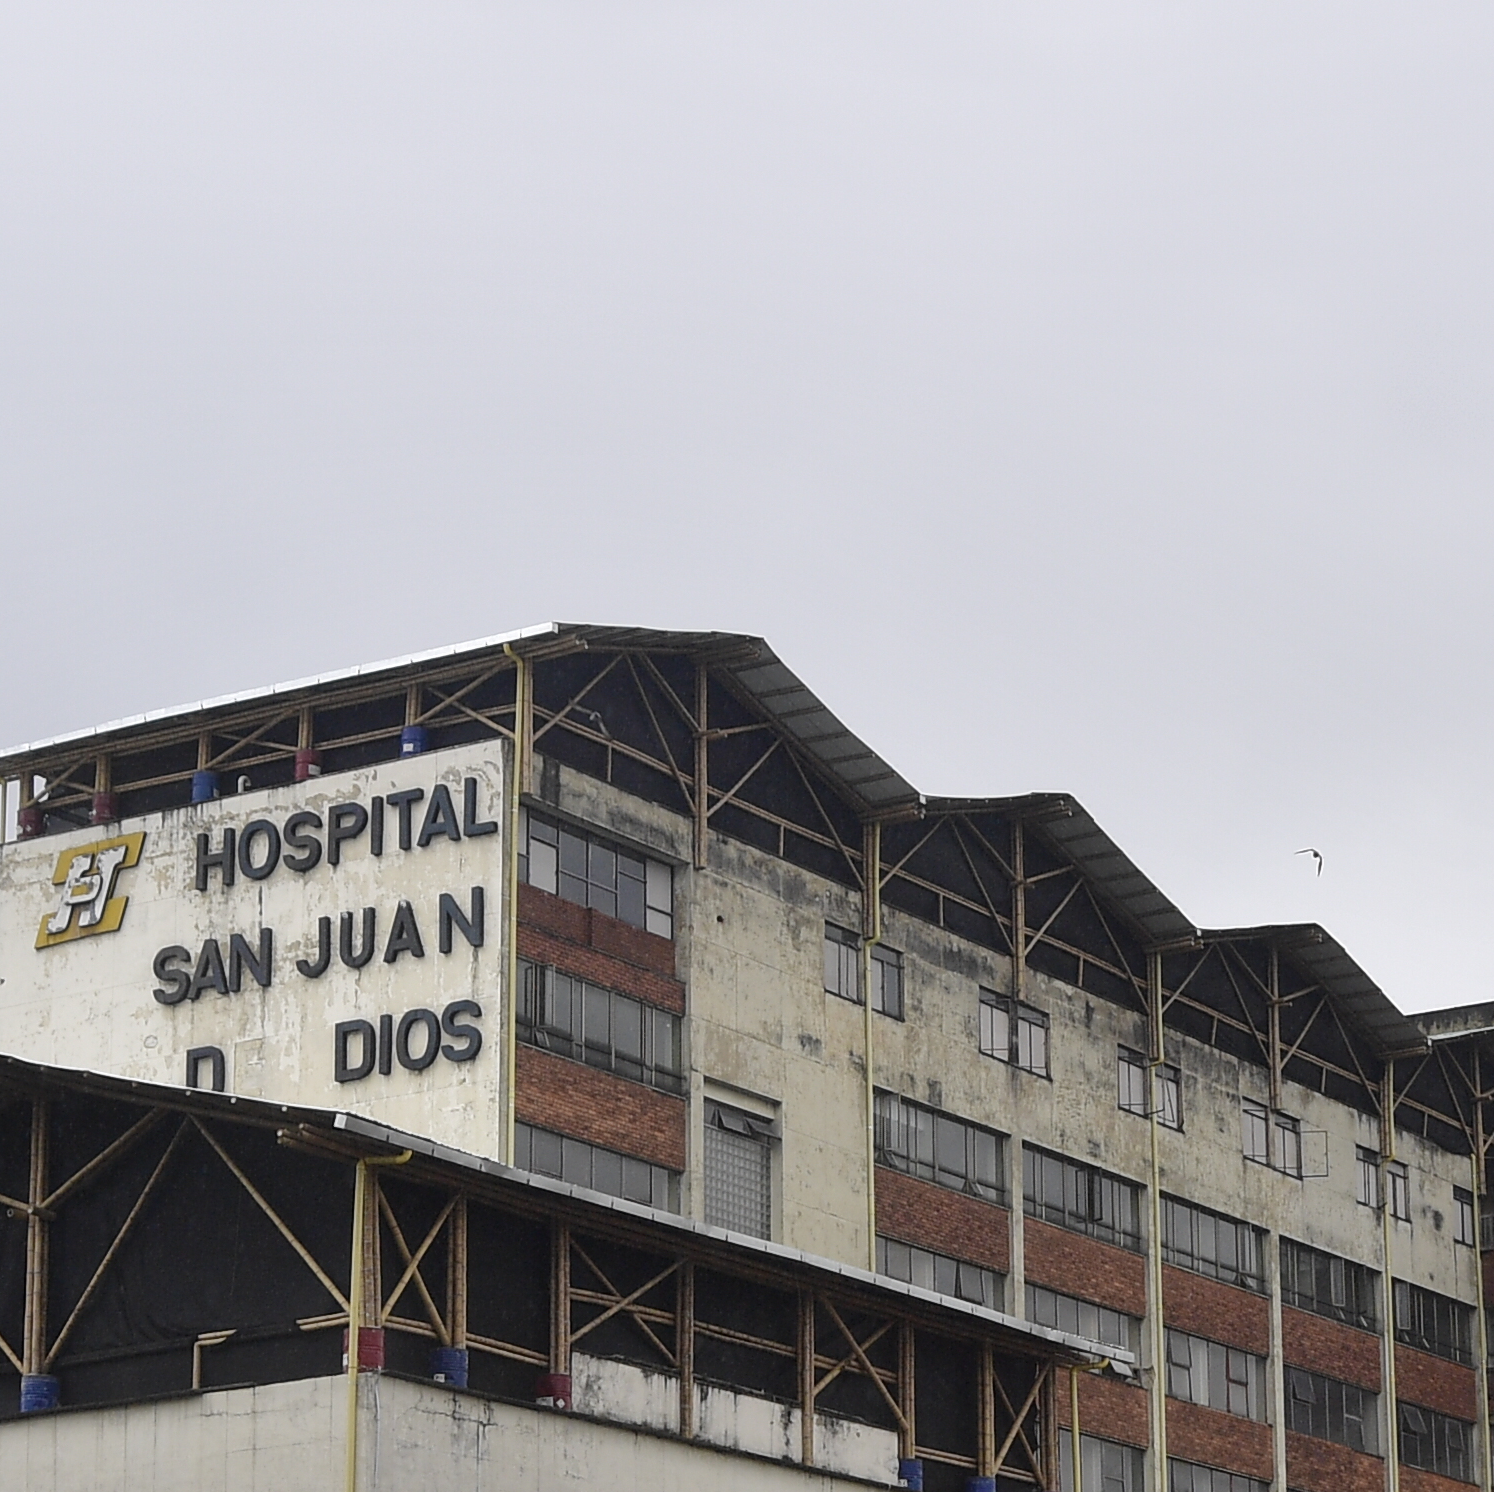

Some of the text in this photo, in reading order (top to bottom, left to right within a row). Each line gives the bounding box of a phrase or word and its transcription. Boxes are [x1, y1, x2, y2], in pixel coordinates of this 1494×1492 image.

[195, 776, 498, 891] HOSPITAL
[152, 885, 485, 1006] SAN JUAN
[334, 999, 483, 1084] DIOS
